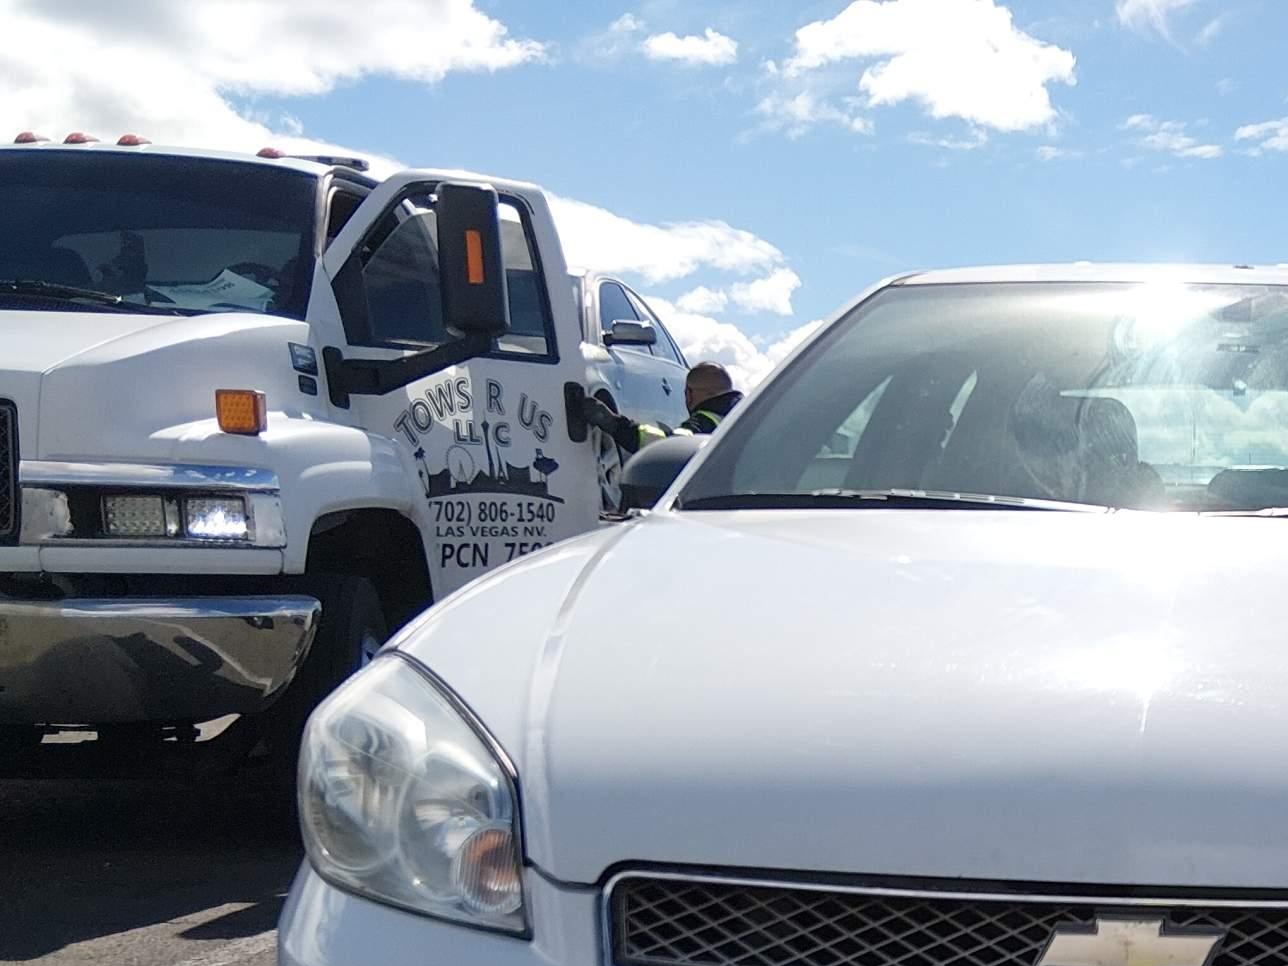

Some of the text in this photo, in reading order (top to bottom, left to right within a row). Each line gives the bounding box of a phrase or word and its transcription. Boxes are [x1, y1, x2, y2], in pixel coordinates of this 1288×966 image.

[393, 376, 553, 447] TOWS R US
[478, 501, 556, 523] 806-1540
[436, 525, 548, 538] LAS VEGAS NV.
[441, 542, 489, 568] PCN
